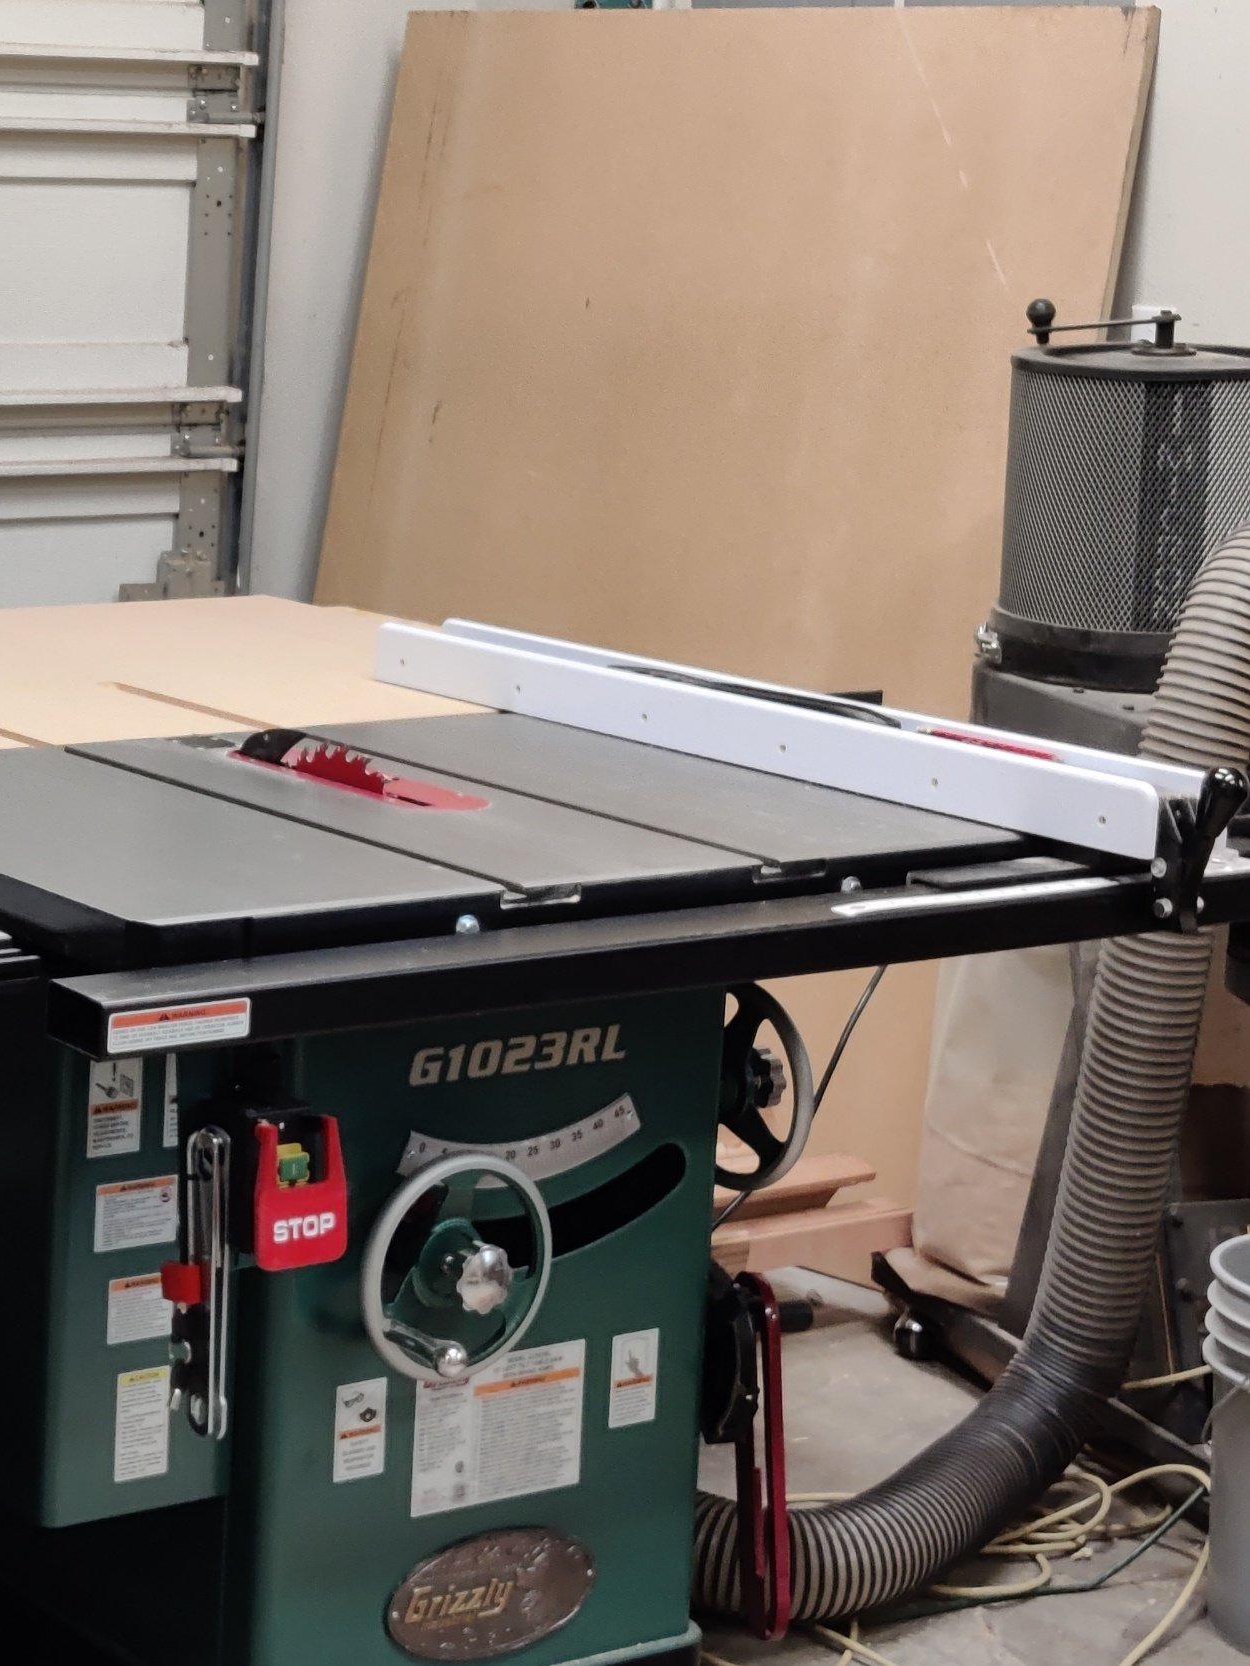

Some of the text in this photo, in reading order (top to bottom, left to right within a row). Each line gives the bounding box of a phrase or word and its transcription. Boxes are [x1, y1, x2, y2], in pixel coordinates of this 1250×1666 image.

[408, 1023, 627, 1087] G1023RL
[528, 1145, 539, 1157] 25
[550, 1138, 561, 1150] 30
[572, 1130, 583, 1141] 35
[593, 1118, 604, 1130] 40
[614, 1105, 625, 1118] 45
[273, 1211, 336, 1244] STOP
[404, 1577, 515, 1625] Grizzly
